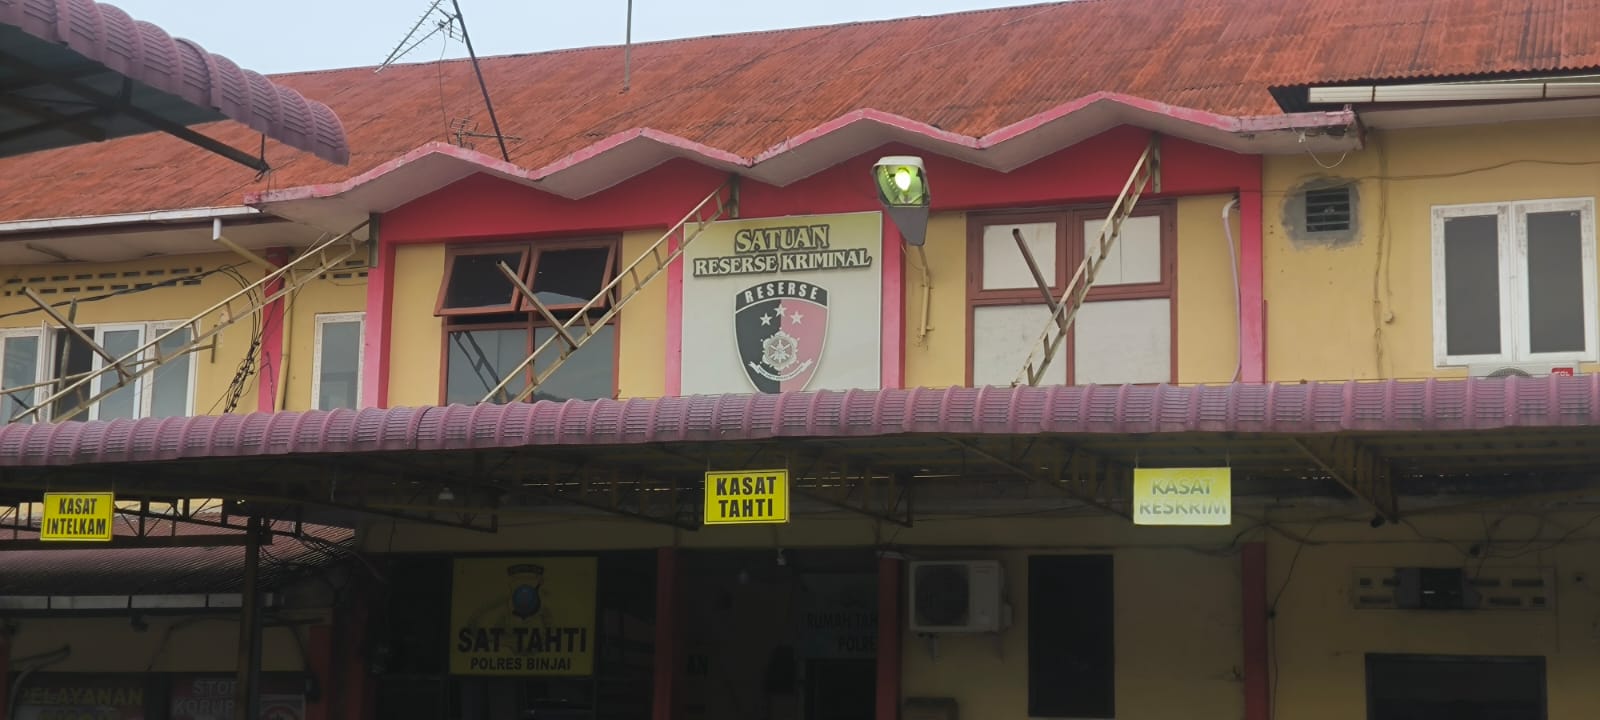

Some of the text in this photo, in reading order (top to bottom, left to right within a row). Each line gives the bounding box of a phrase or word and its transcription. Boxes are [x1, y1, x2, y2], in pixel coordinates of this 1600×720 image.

[735, 224, 830, 253] SATUAN
[694, 248, 872, 277] RESERSE KRIMINAL
[744, 281, 819, 304] RESERSE
[716, 476, 777, 496] KASAT
[1151, 479, 1213, 495] KASAT
[59, 498, 97, 515] KASAT
[718, 499, 773, 518] TAHTI
[46, 518, 106, 535] INTELKAM
[457, 628, 587, 653] SAT TAHTI
[470, 657, 571, 671] POLRES BINJAI
